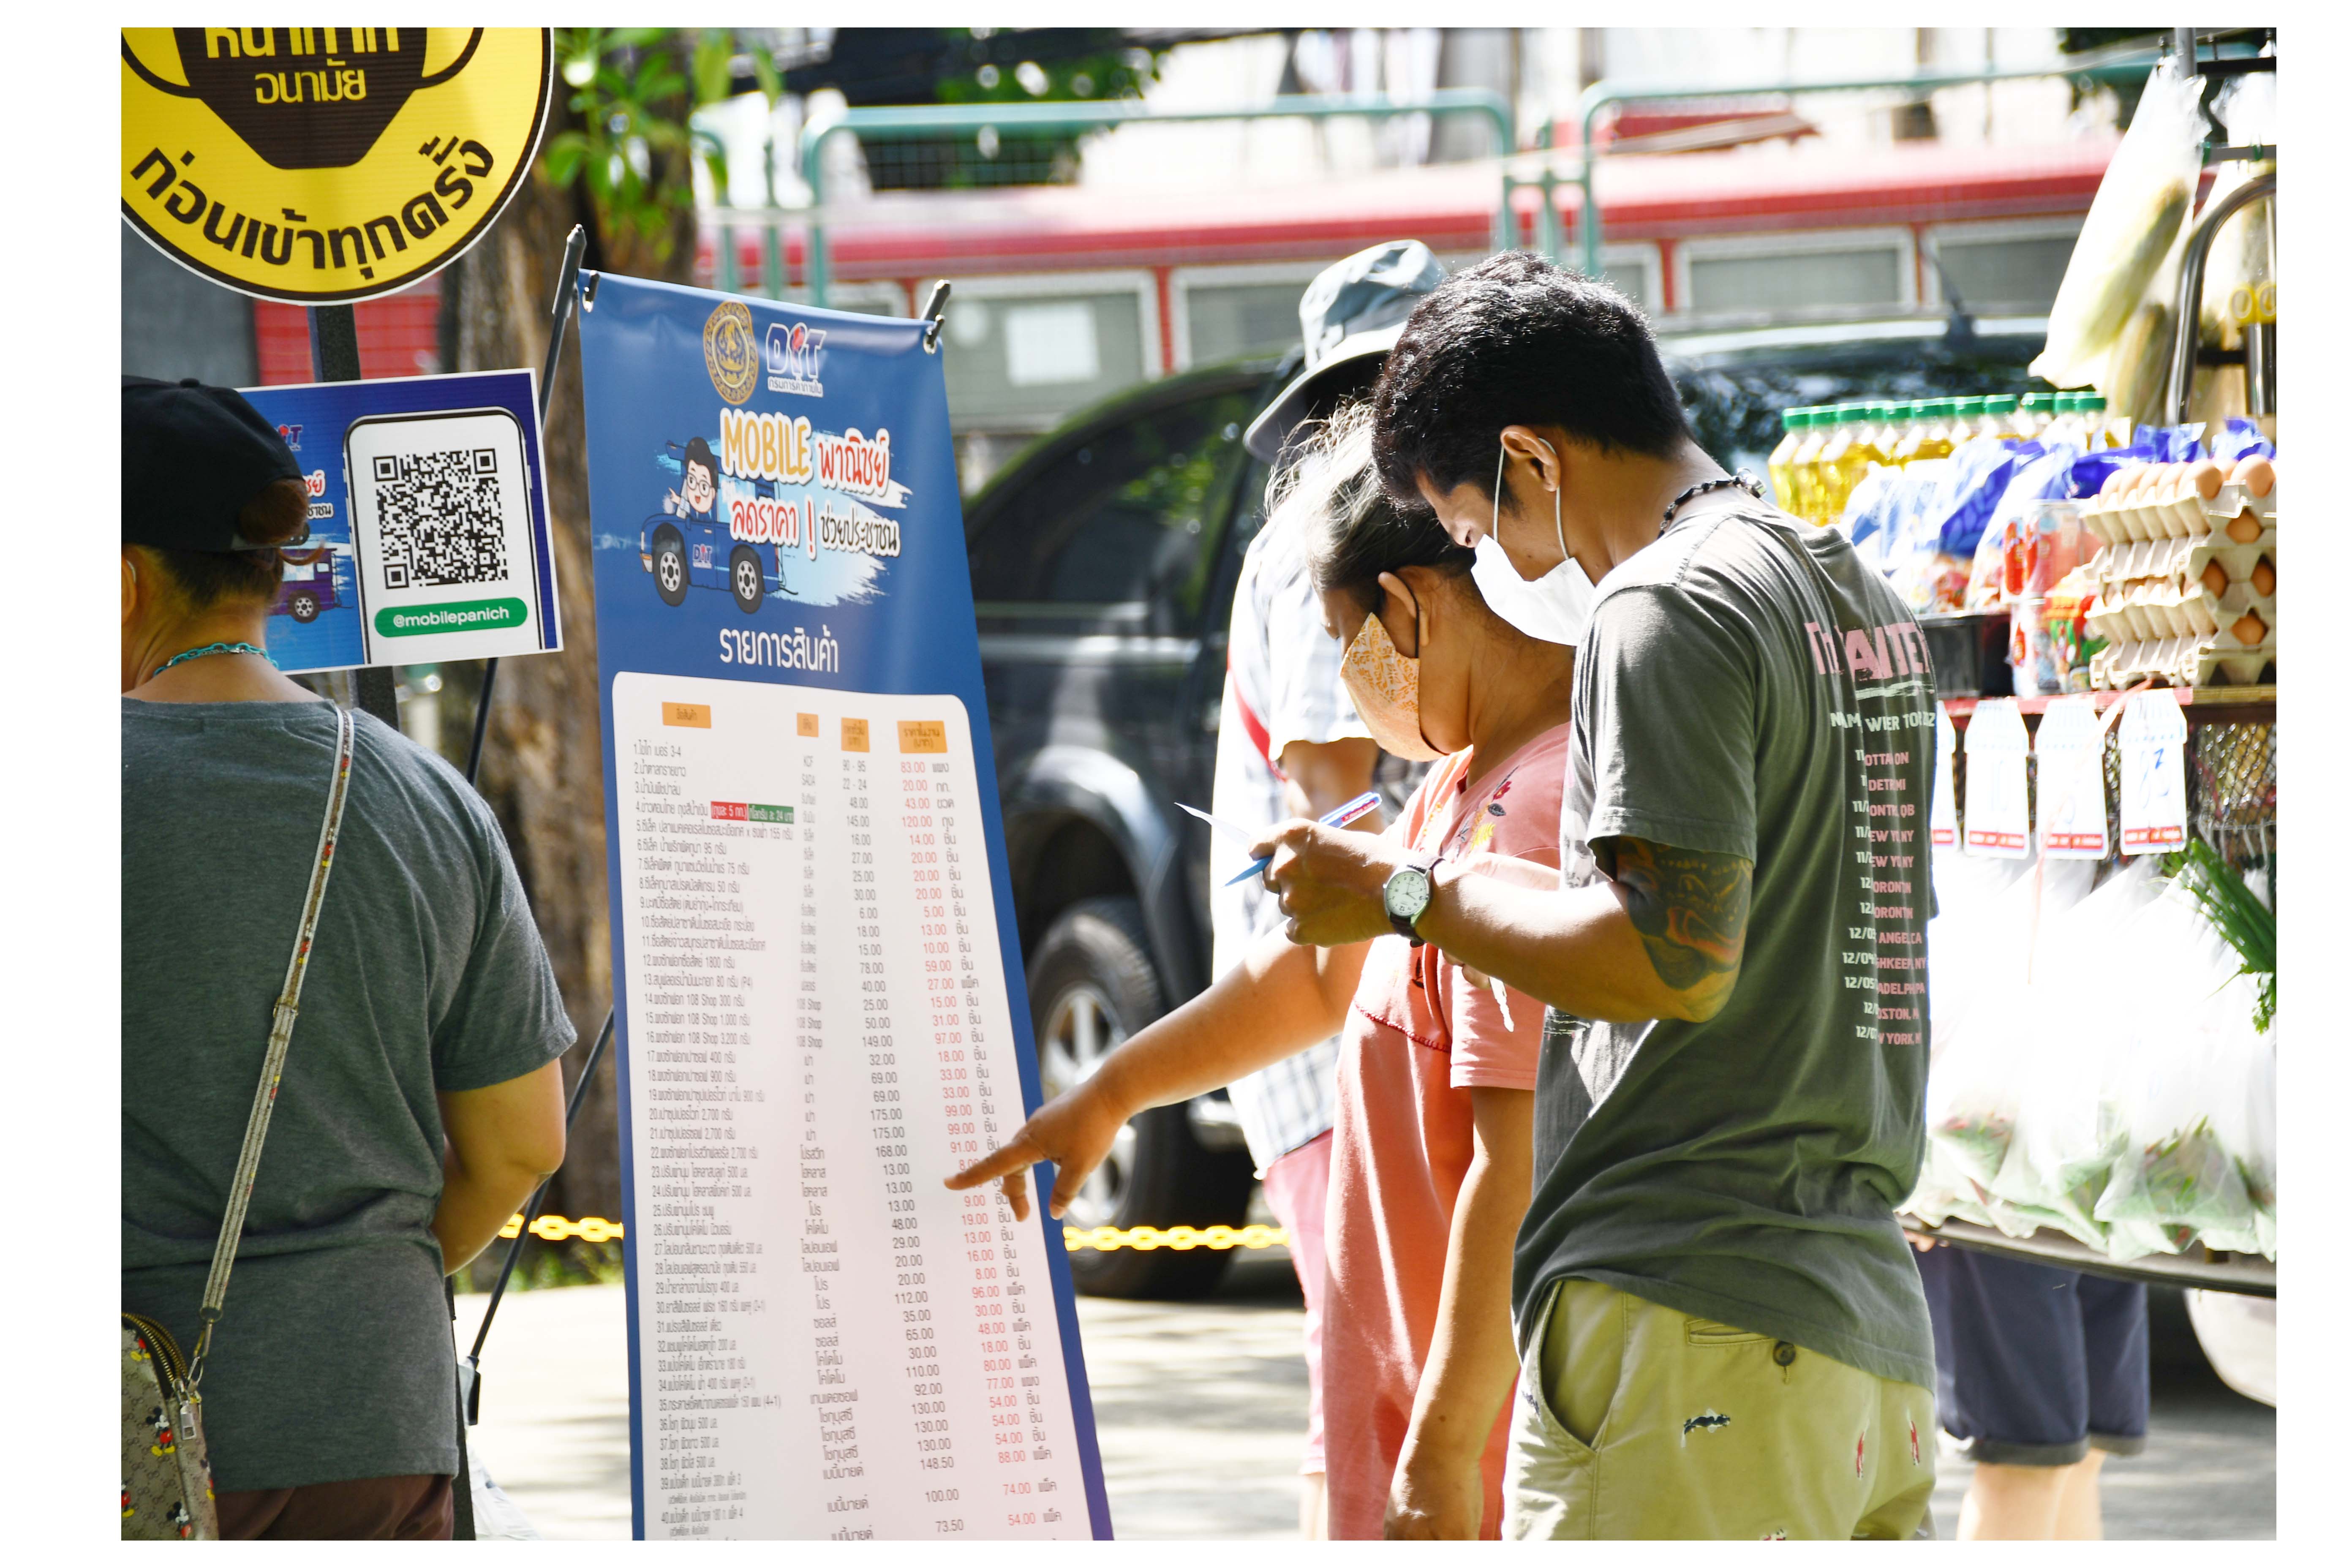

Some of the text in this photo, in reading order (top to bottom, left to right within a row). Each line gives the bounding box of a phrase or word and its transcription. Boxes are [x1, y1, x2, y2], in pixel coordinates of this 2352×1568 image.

[255, 58, 367, 104] อนามัย
[131, 136, 494, 280] ก่อนเข้าทุกครั้ง
[724, 414, 888, 488] MOBILE พาณิชย์
[732, 500, 899, 555] ลดราคา ! ช่วยประชาชน
[393, 607, 509, 628] @mobilepanich
[720, 625, 840, 672] รายการสินค้า
[900, 761, 926, 773] 83.00
[902, 779, 928, 791] 20.00
[905, 798, 930, 809] 43.00
[901, 816, 932, 828] 120.00
[909, 833, 935, 845] 14.00
[1870, 830, 1889, 842] EW
[852, 852, 937, 864] 27.00 20.00
[1872, 856, 1888, 868] EW
[853, 869, 939, 882] 25.00 20.00
[855, 887, 942, 900] 30.00 20.00
[860, 906, 945, 919] 6.00 5.00
[858, 926, 879, 937] 18.00
[921, 923, 946, 936] 13.00
[859, 942, 949, 956] 15.00 10.00
[860, 960, 952, 974] 78.00 59.00
[862, 980, 885, 992] 40.00
[927, 977, 954, 991] 27.00
[863, 999, 888, 1010] 25.00
[931, 996, 957, 1008] 15.00
[866, 1017, 890, 1029] 50.00
[933, 1014, 959, 1027] 31.00
[863, 1035, 892, 1047] 149.00
[934, 1032, 962, 1045] 97.00
[869, 1050, 964, 1066] 32.00 18.00
[871, 1072, 897, 1084] 69.00
[940, 1068, 966, 1081] 33.00
[874, 1086, 970, 1102] 69.00 33.00
[871, 1104, 972, 1120] 175.00 99.00
[873, 1126, 904, 1139] 175.00
[947, 1122, 975, 1135] 99.00
[875, 1140, 978, 1157] 168.00 91.00
[883, 1163, 909, 1175] 13.00
[885, 1181, 912, 1194] 13.00
[888, 1199, 915, 1212] 13.00
[964, 1195, 986, 1208] 9.00
[892, 1217, 917, 1230] 48.00
[961, 1212, 988, 1226] 19.00
[893, 1236, 920, 1249] 29.00
[964, 1230, 991, 1244] 13.00
[895, 1249, 994, 1267] 20.00 16.00
[898, 1273, 925, 1285] 20.00
[975, 1267, 997, 1280] 8.00
[895, 1291, 928, 1304] 112.00
[972, 1285, 1000, 1299] 96.00
[903, 1309, 931, 1322] 35.00
[975, 1304, 1003, 1317] 30.00
[906, 1322, 1006, 1341] 65.00 48.00
[909, 1346, 936, 1359] 30.00
[981, 1340, 1009, 1354] 18.00
[906, 1358, 1012, 1377] 110.00 80.00
[915, 1376, 1015, 1396] 92.00 77.00
[912, 1401, 945, 1414] 130.00
[989, 1395, 1018, 1408] 54.00
[915, 1413, 1021, 1432] 130.00 54.00
[917, 1431, 1024, 1451] 130.00 54.00
[920, 1456, 954, 1470] 148.50
[998, 1450, 1026, 1464] 88.00
[925, 1489, 959, 1502] 100.00
[1003, 1482, 1031, 1496] 74.00
[935, 1519, 964, 1532] 73.50
[1008, 1512, 1036, 1526] 54.00
